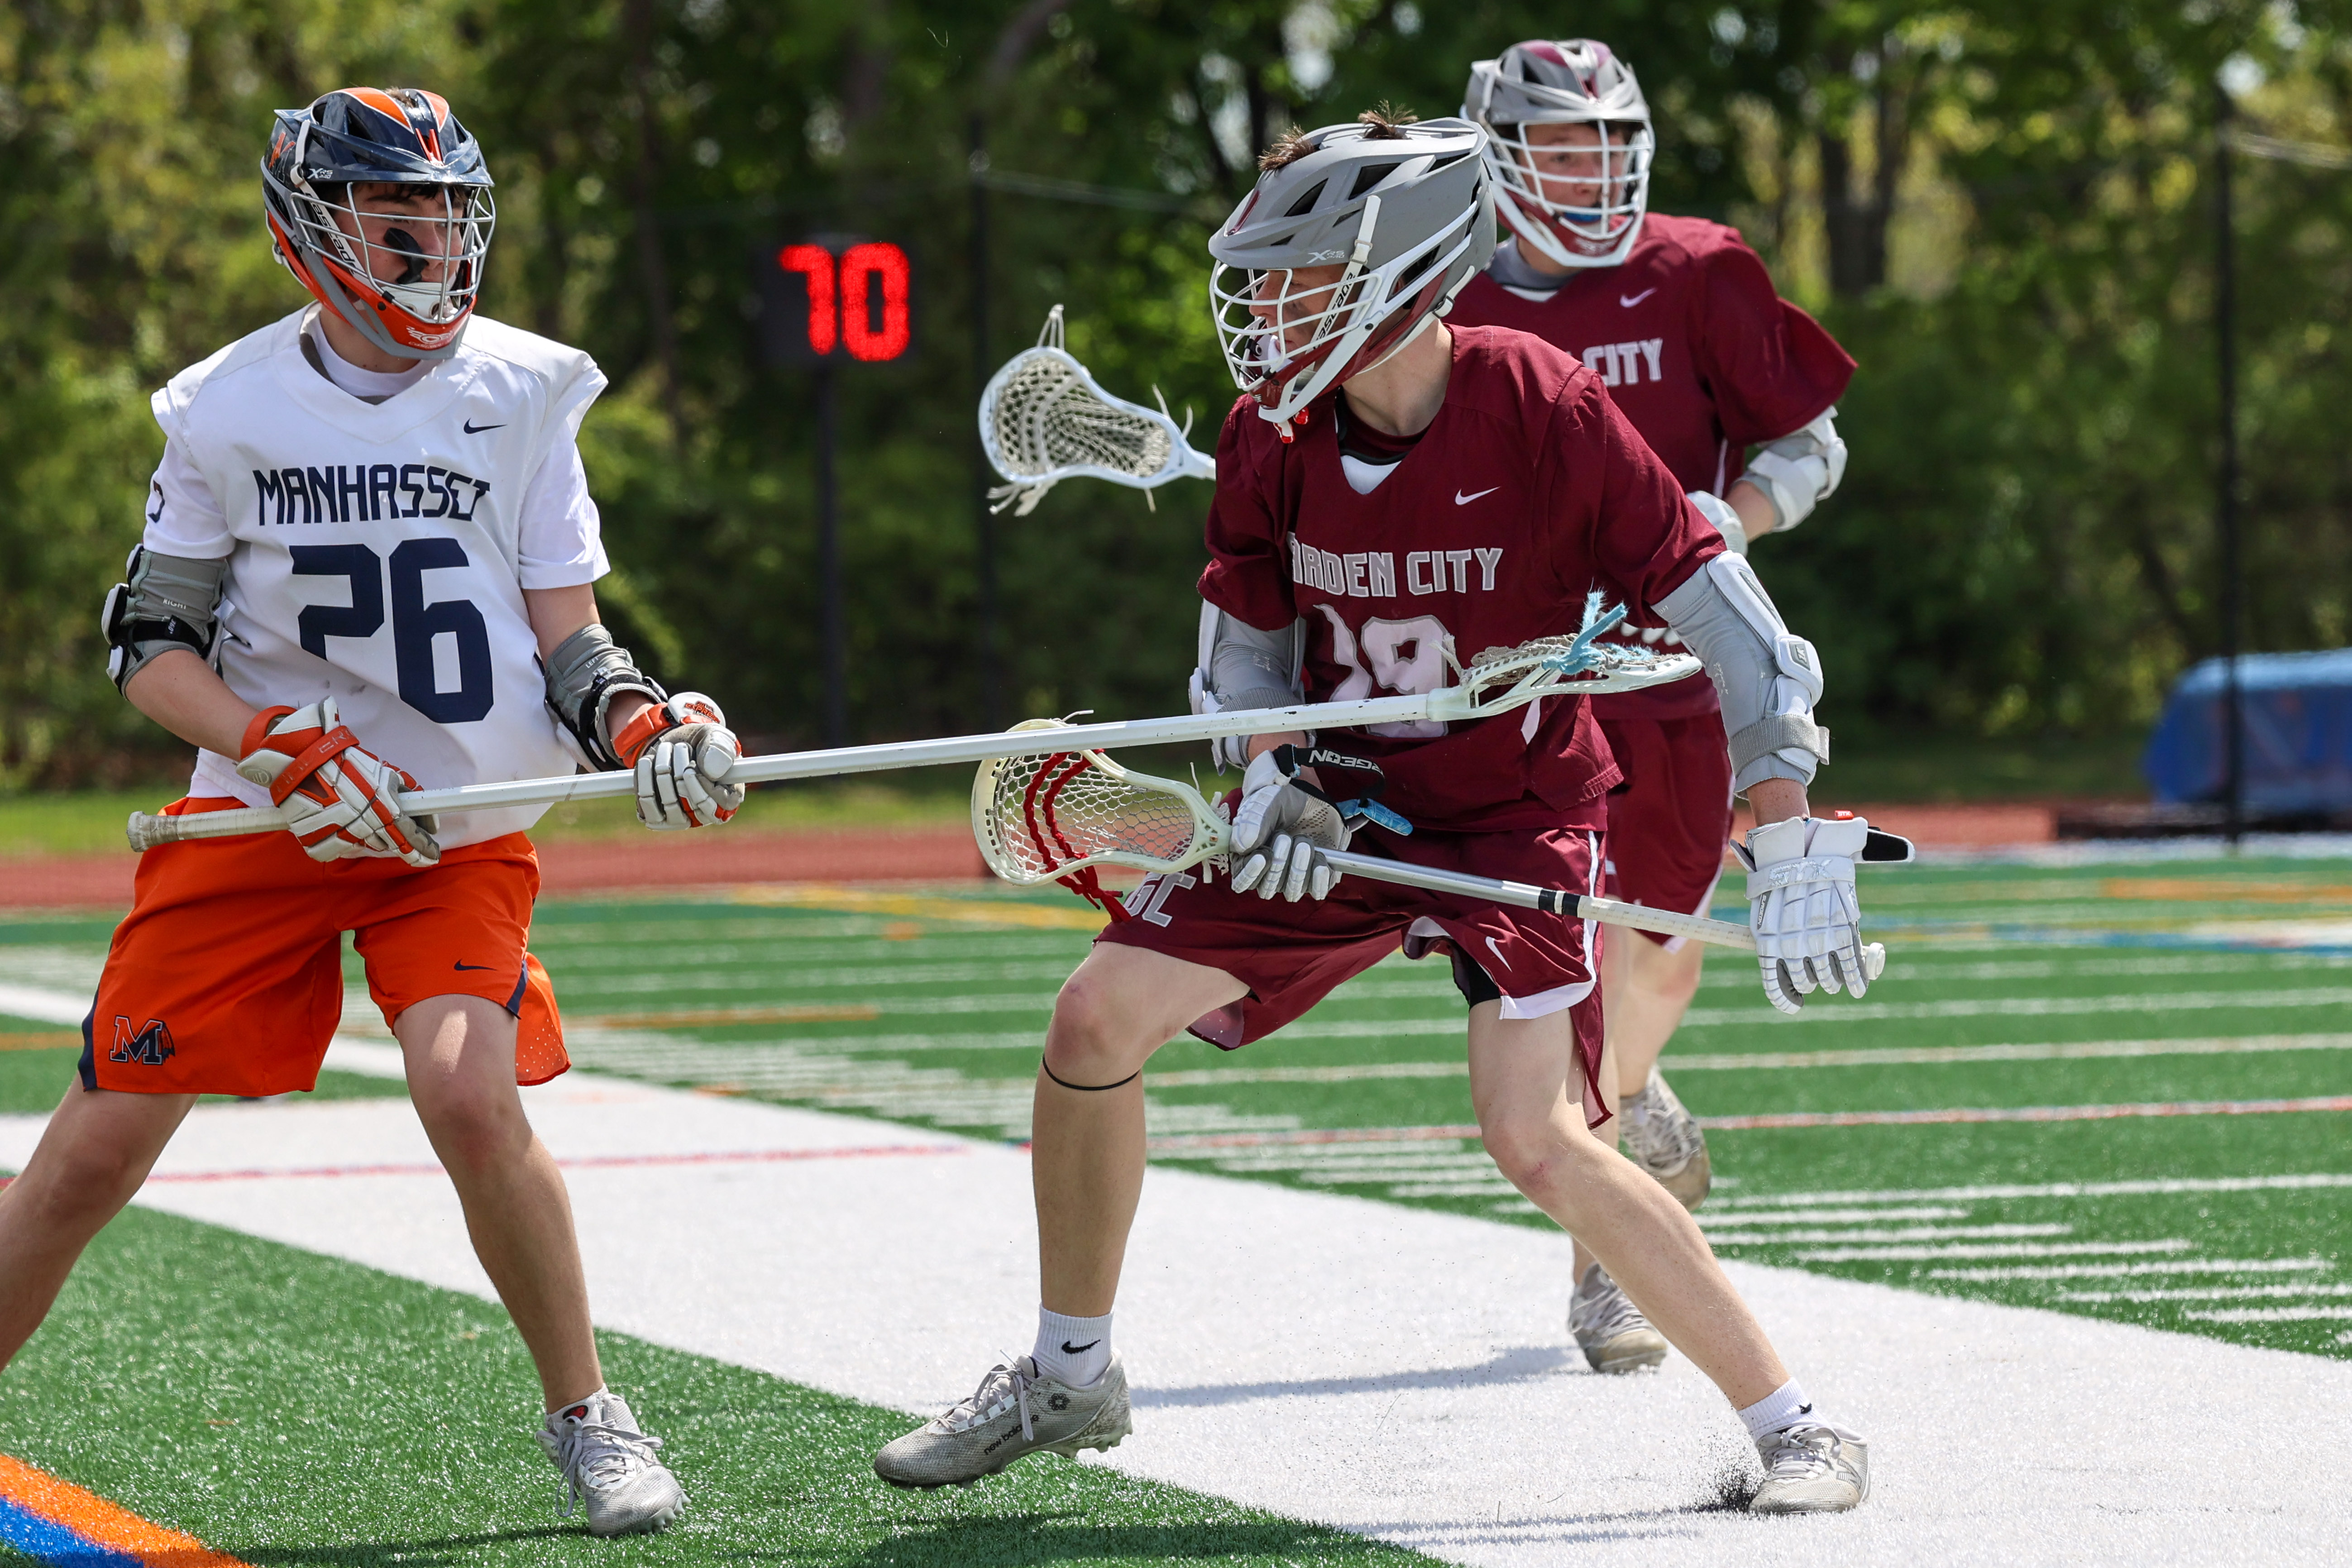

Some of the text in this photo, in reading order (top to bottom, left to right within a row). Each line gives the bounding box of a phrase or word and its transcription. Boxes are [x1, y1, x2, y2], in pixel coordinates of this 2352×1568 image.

[778, 242, 910, 362] 70
[1582, 337, 1663, 387] CITY
[252, 464, 490, 526] MANHASSET
[1286, 531, 1503, 597] ARDEN CITY
[289, 538, 494, 723] 26
[585, 656, 598, 668] LEFT
[1309, 750, 1384, 777] RGEON
[110, 1015, 163, 1065] M
[984, 1415, 1039, 1455] new balae
